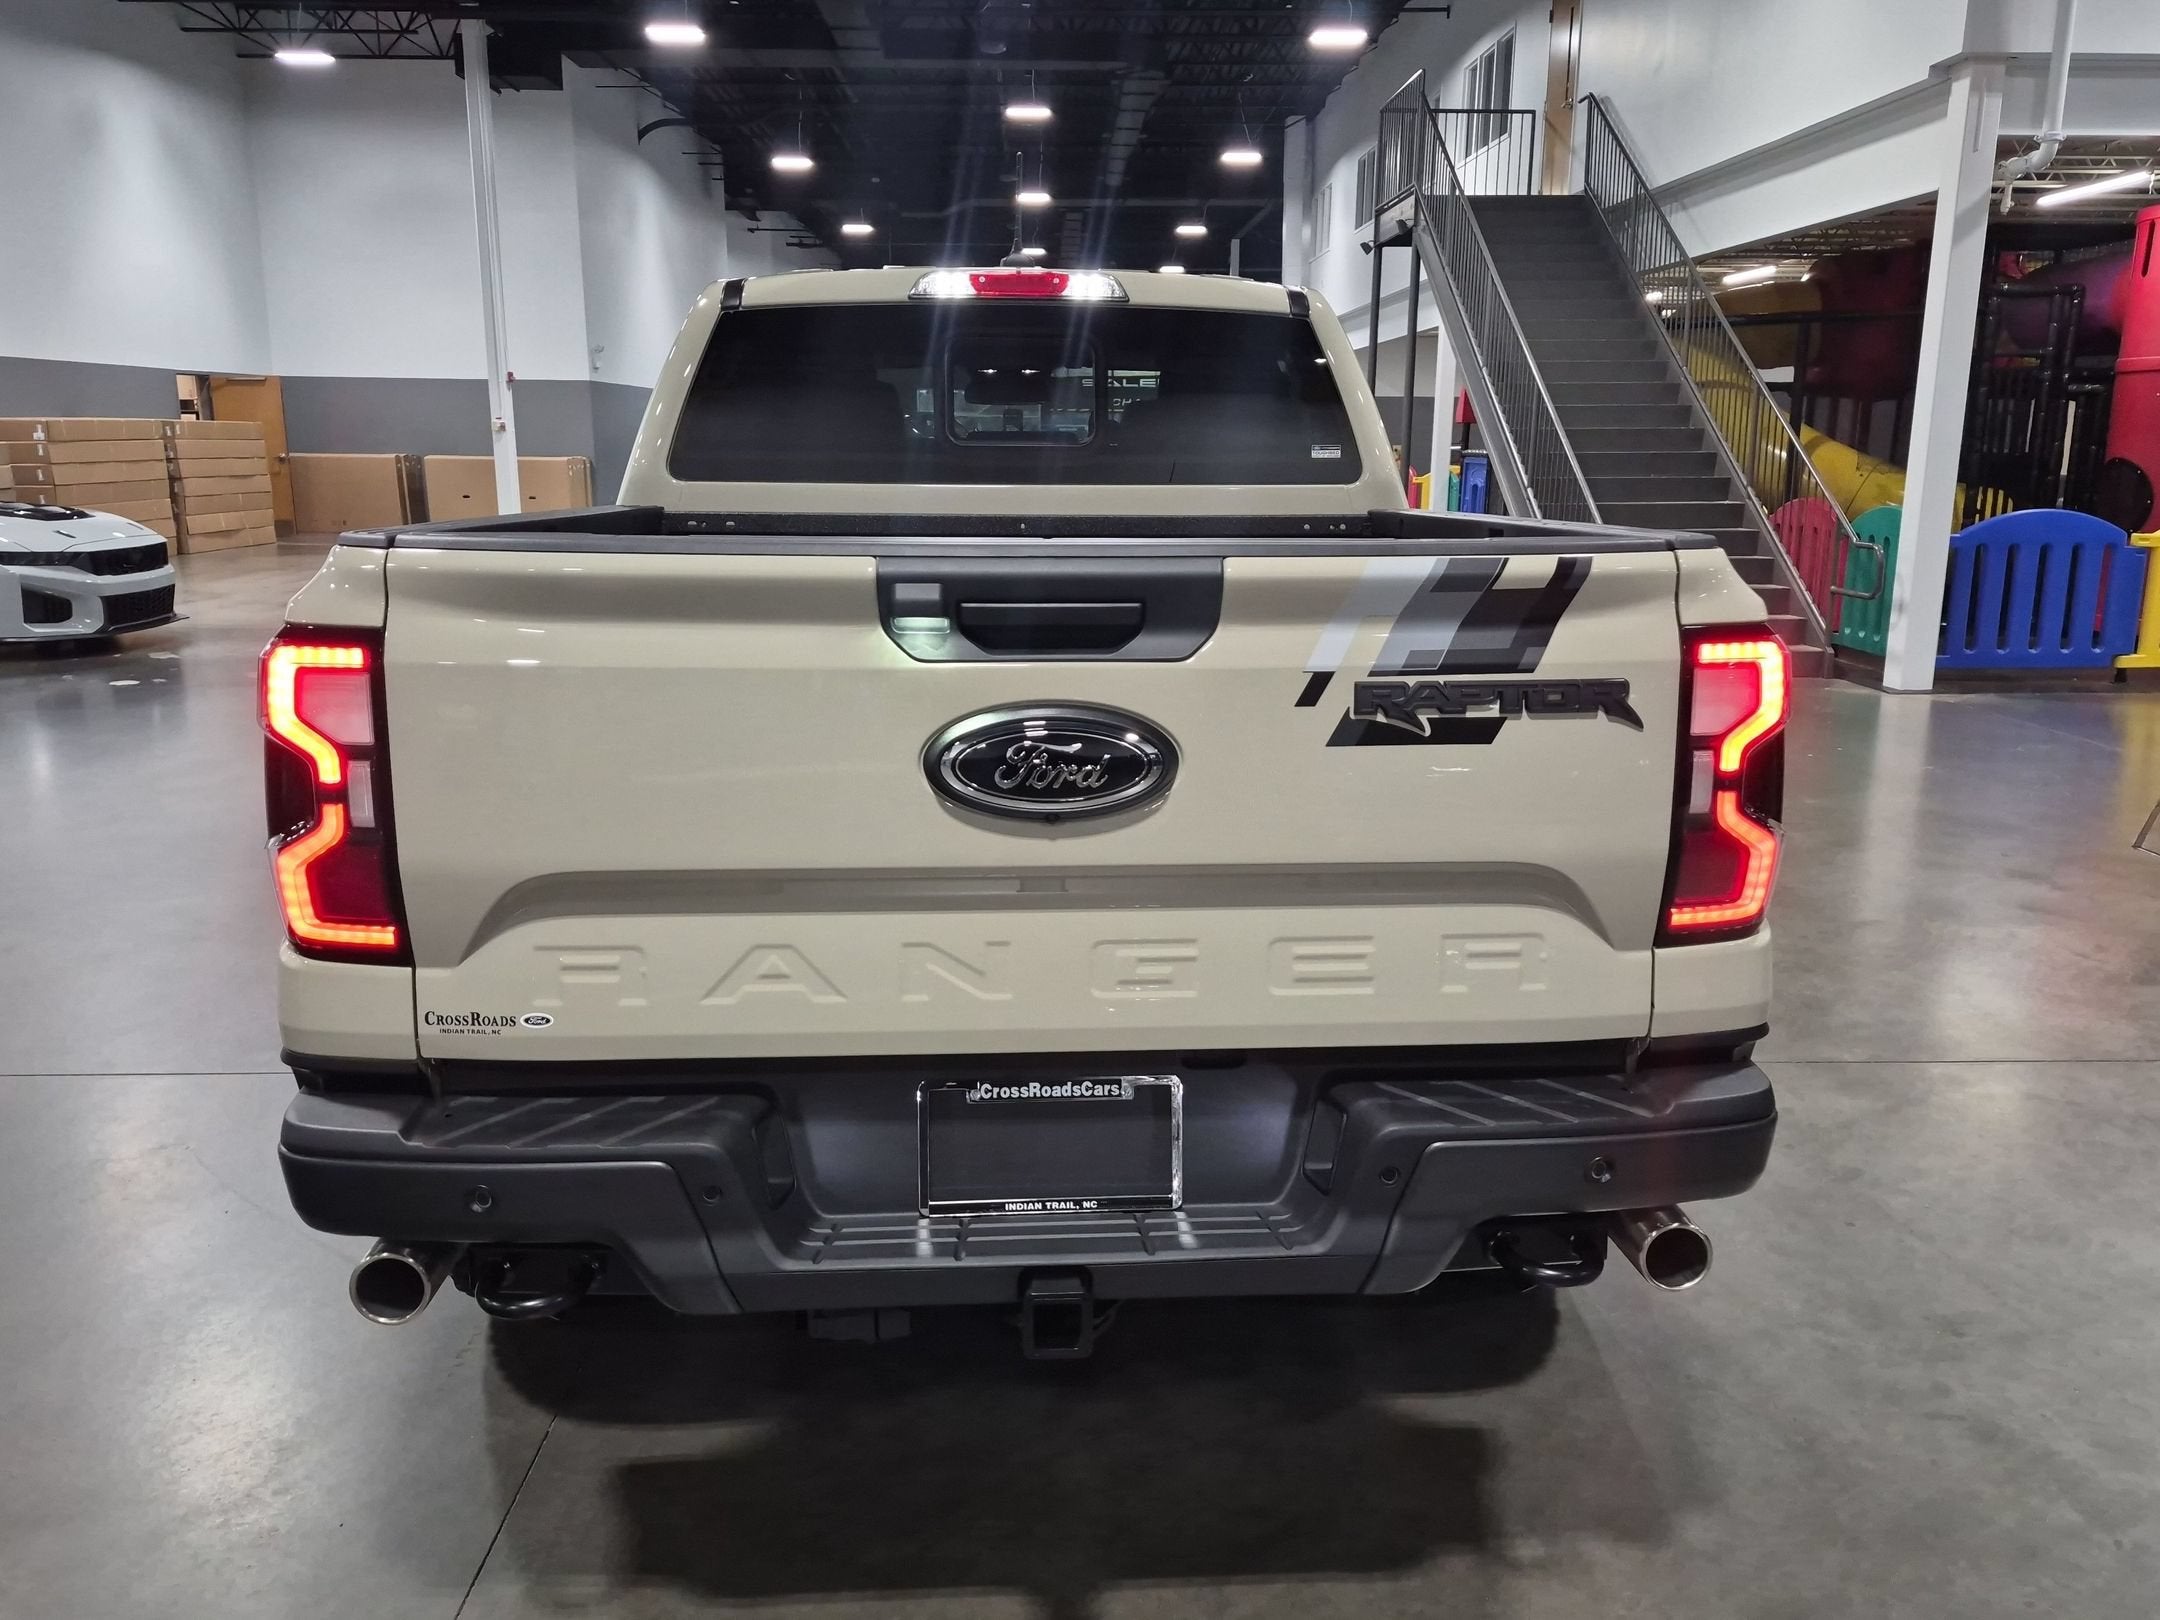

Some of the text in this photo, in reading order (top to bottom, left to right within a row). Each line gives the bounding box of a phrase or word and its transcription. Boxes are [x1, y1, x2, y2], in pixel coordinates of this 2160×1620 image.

[1353, 678, 1644, 733] RAPTOR
[994, 740, 1111, 789] Ford
[532, 931, 1548, 1006] RANGER
[980, 1081, 1120, 1099] CrossRoadsCars
[1005, 1203, 1042, 1211] INDIAN
[1045, 1202, 1079, 1210] TRAIL,
